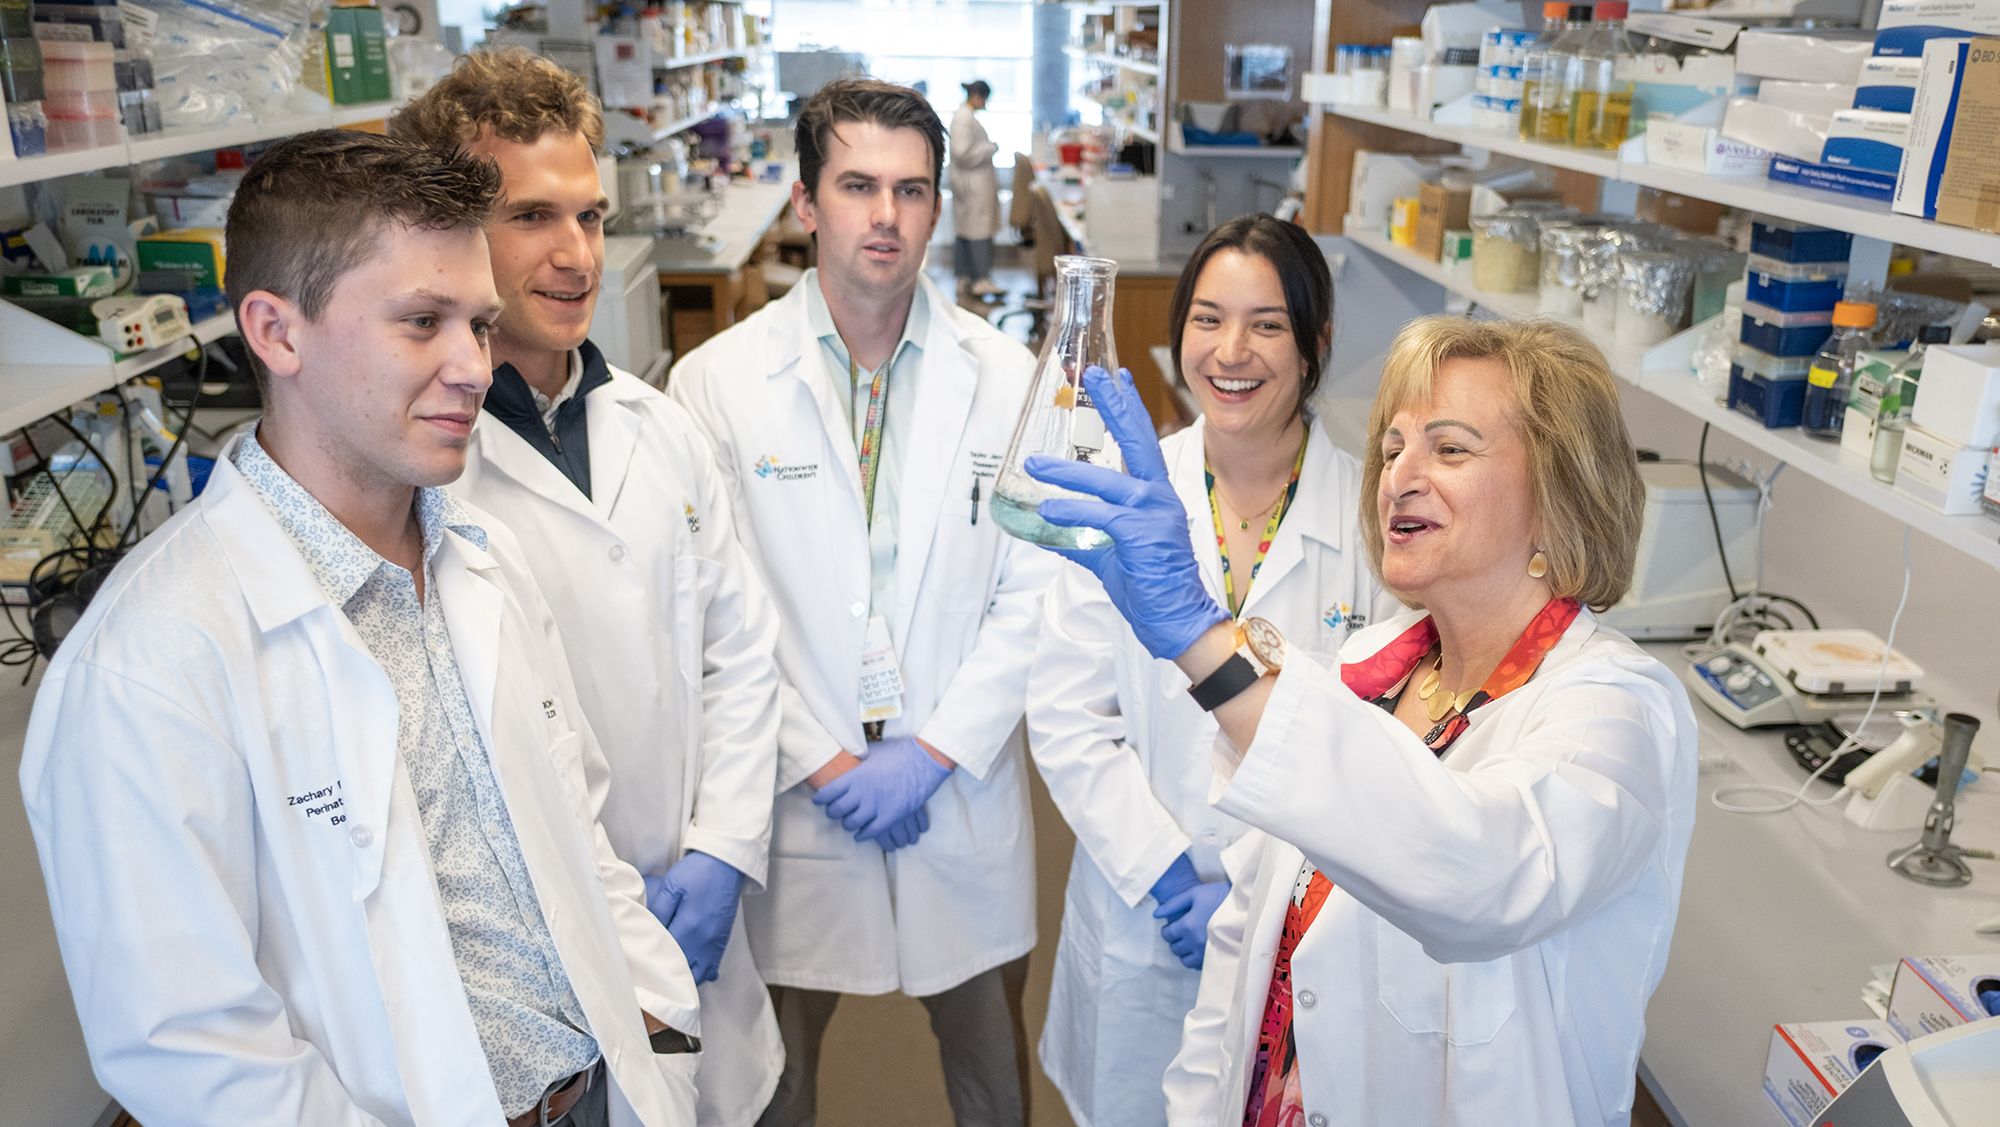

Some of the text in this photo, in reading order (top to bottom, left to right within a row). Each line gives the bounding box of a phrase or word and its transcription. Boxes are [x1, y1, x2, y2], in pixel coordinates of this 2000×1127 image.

[1981, 50, 1996, 63] BD
[1905, 442, 1934, 462] BECKMAN
[286, 785, 333, 806] Zachary
[305, 797, 344, 818] Perinat
[330, 814, 347, 826] Be
